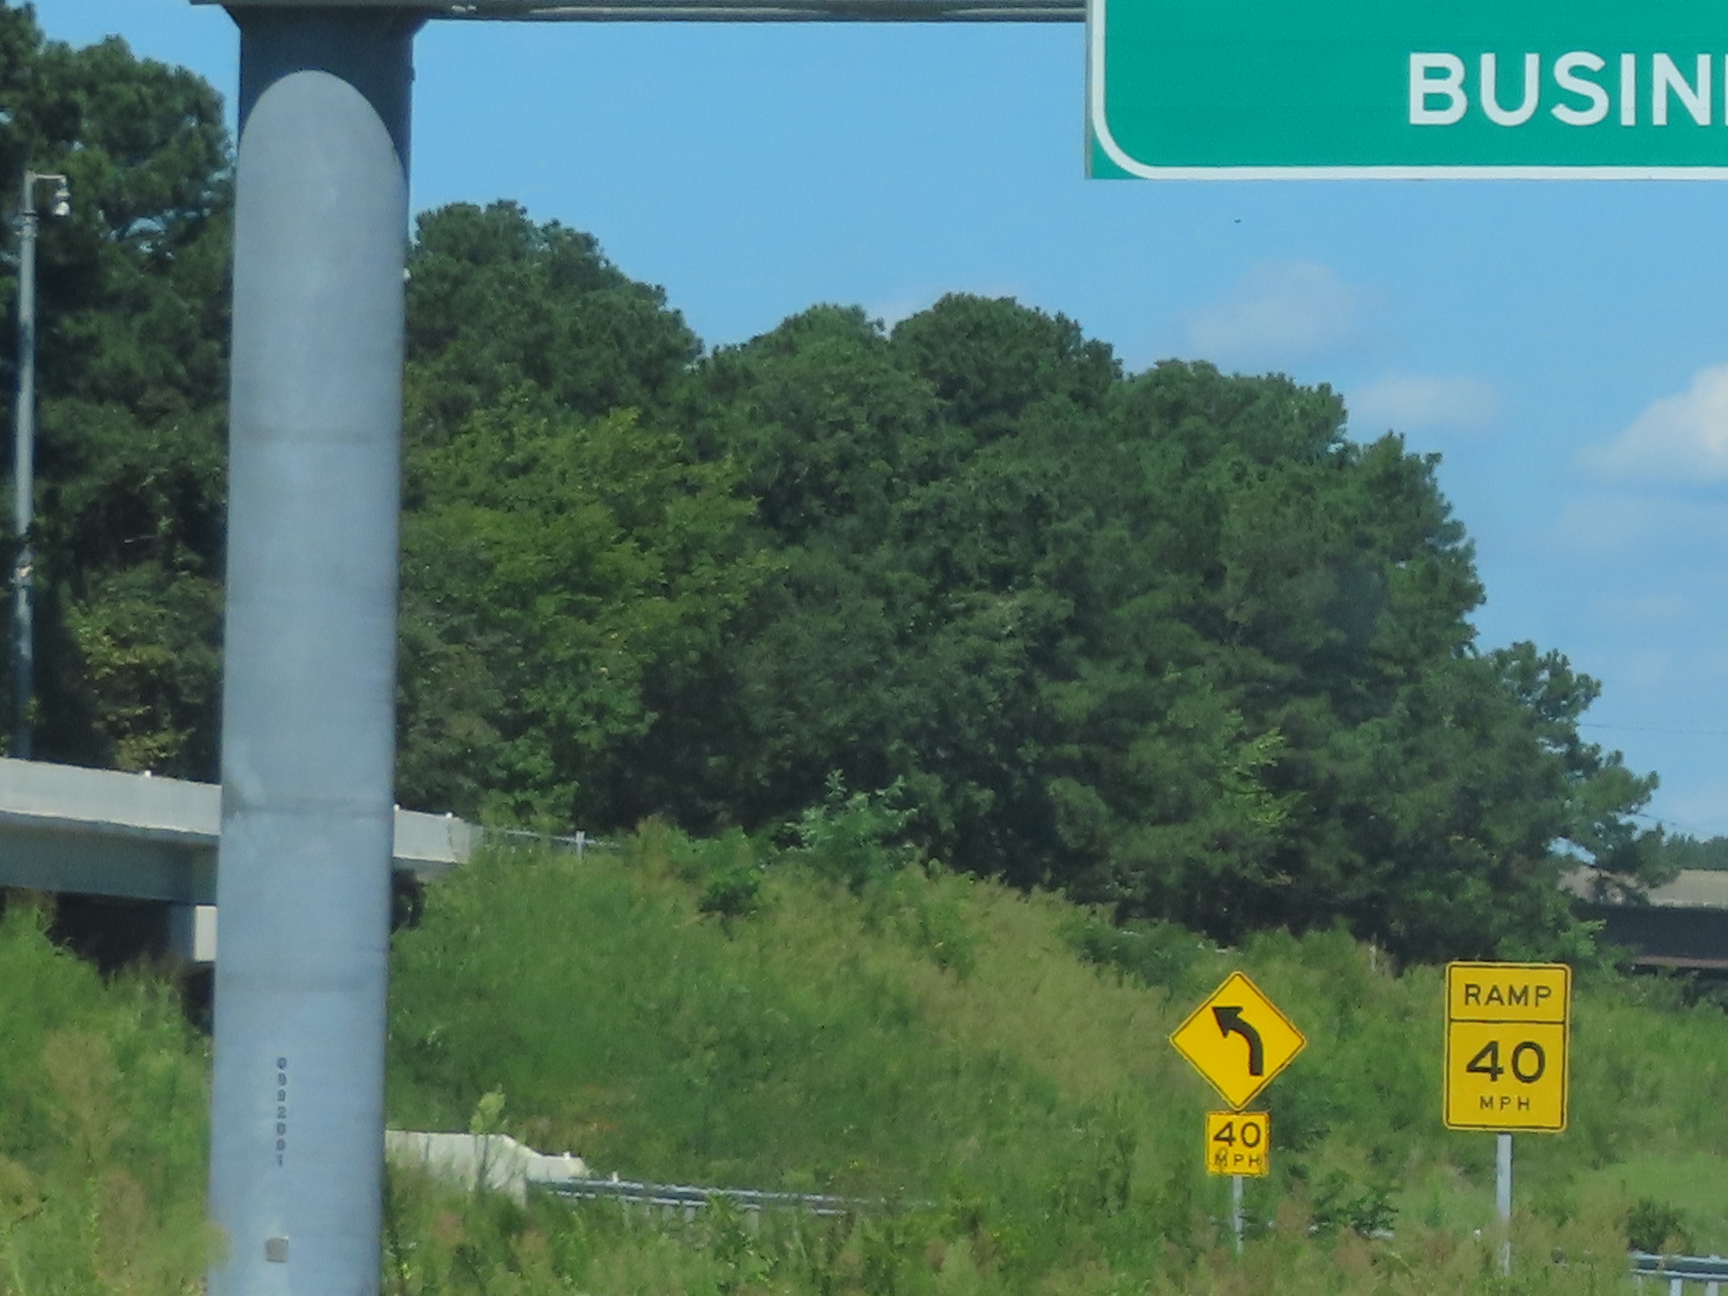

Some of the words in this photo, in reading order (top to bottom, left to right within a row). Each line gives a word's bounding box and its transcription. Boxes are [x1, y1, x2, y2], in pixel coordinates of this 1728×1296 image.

[1464, 982, 1553, 1007] RAMP
[1466, 1040, 1546, 1085] 40
[1479, 1094, 1531, 1112] MPH
[1213, 1121, 1261, 1148] 40
[1214, 1153, 1263, 1167] MPH
